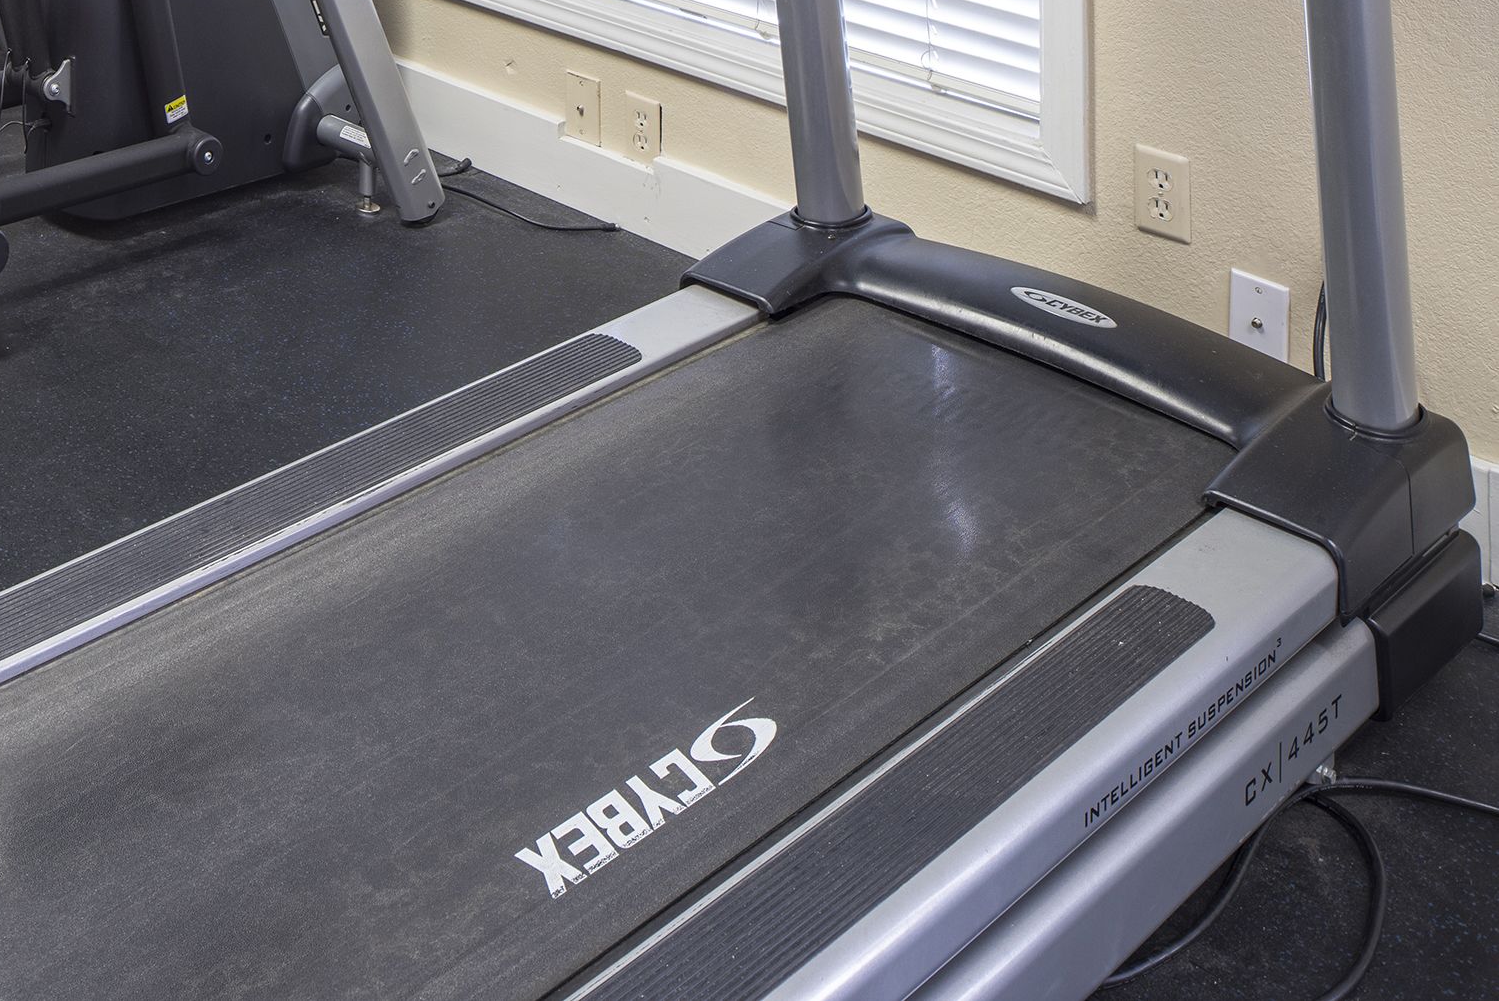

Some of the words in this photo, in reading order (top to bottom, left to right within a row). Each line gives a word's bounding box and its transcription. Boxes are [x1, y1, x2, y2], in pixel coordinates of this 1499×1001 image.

[1045, 298, 1108, 324] CYBEX
[514, 748, 717, 900] CYBEX
[1084, 731, 1183, 828] INTELLIGENT
